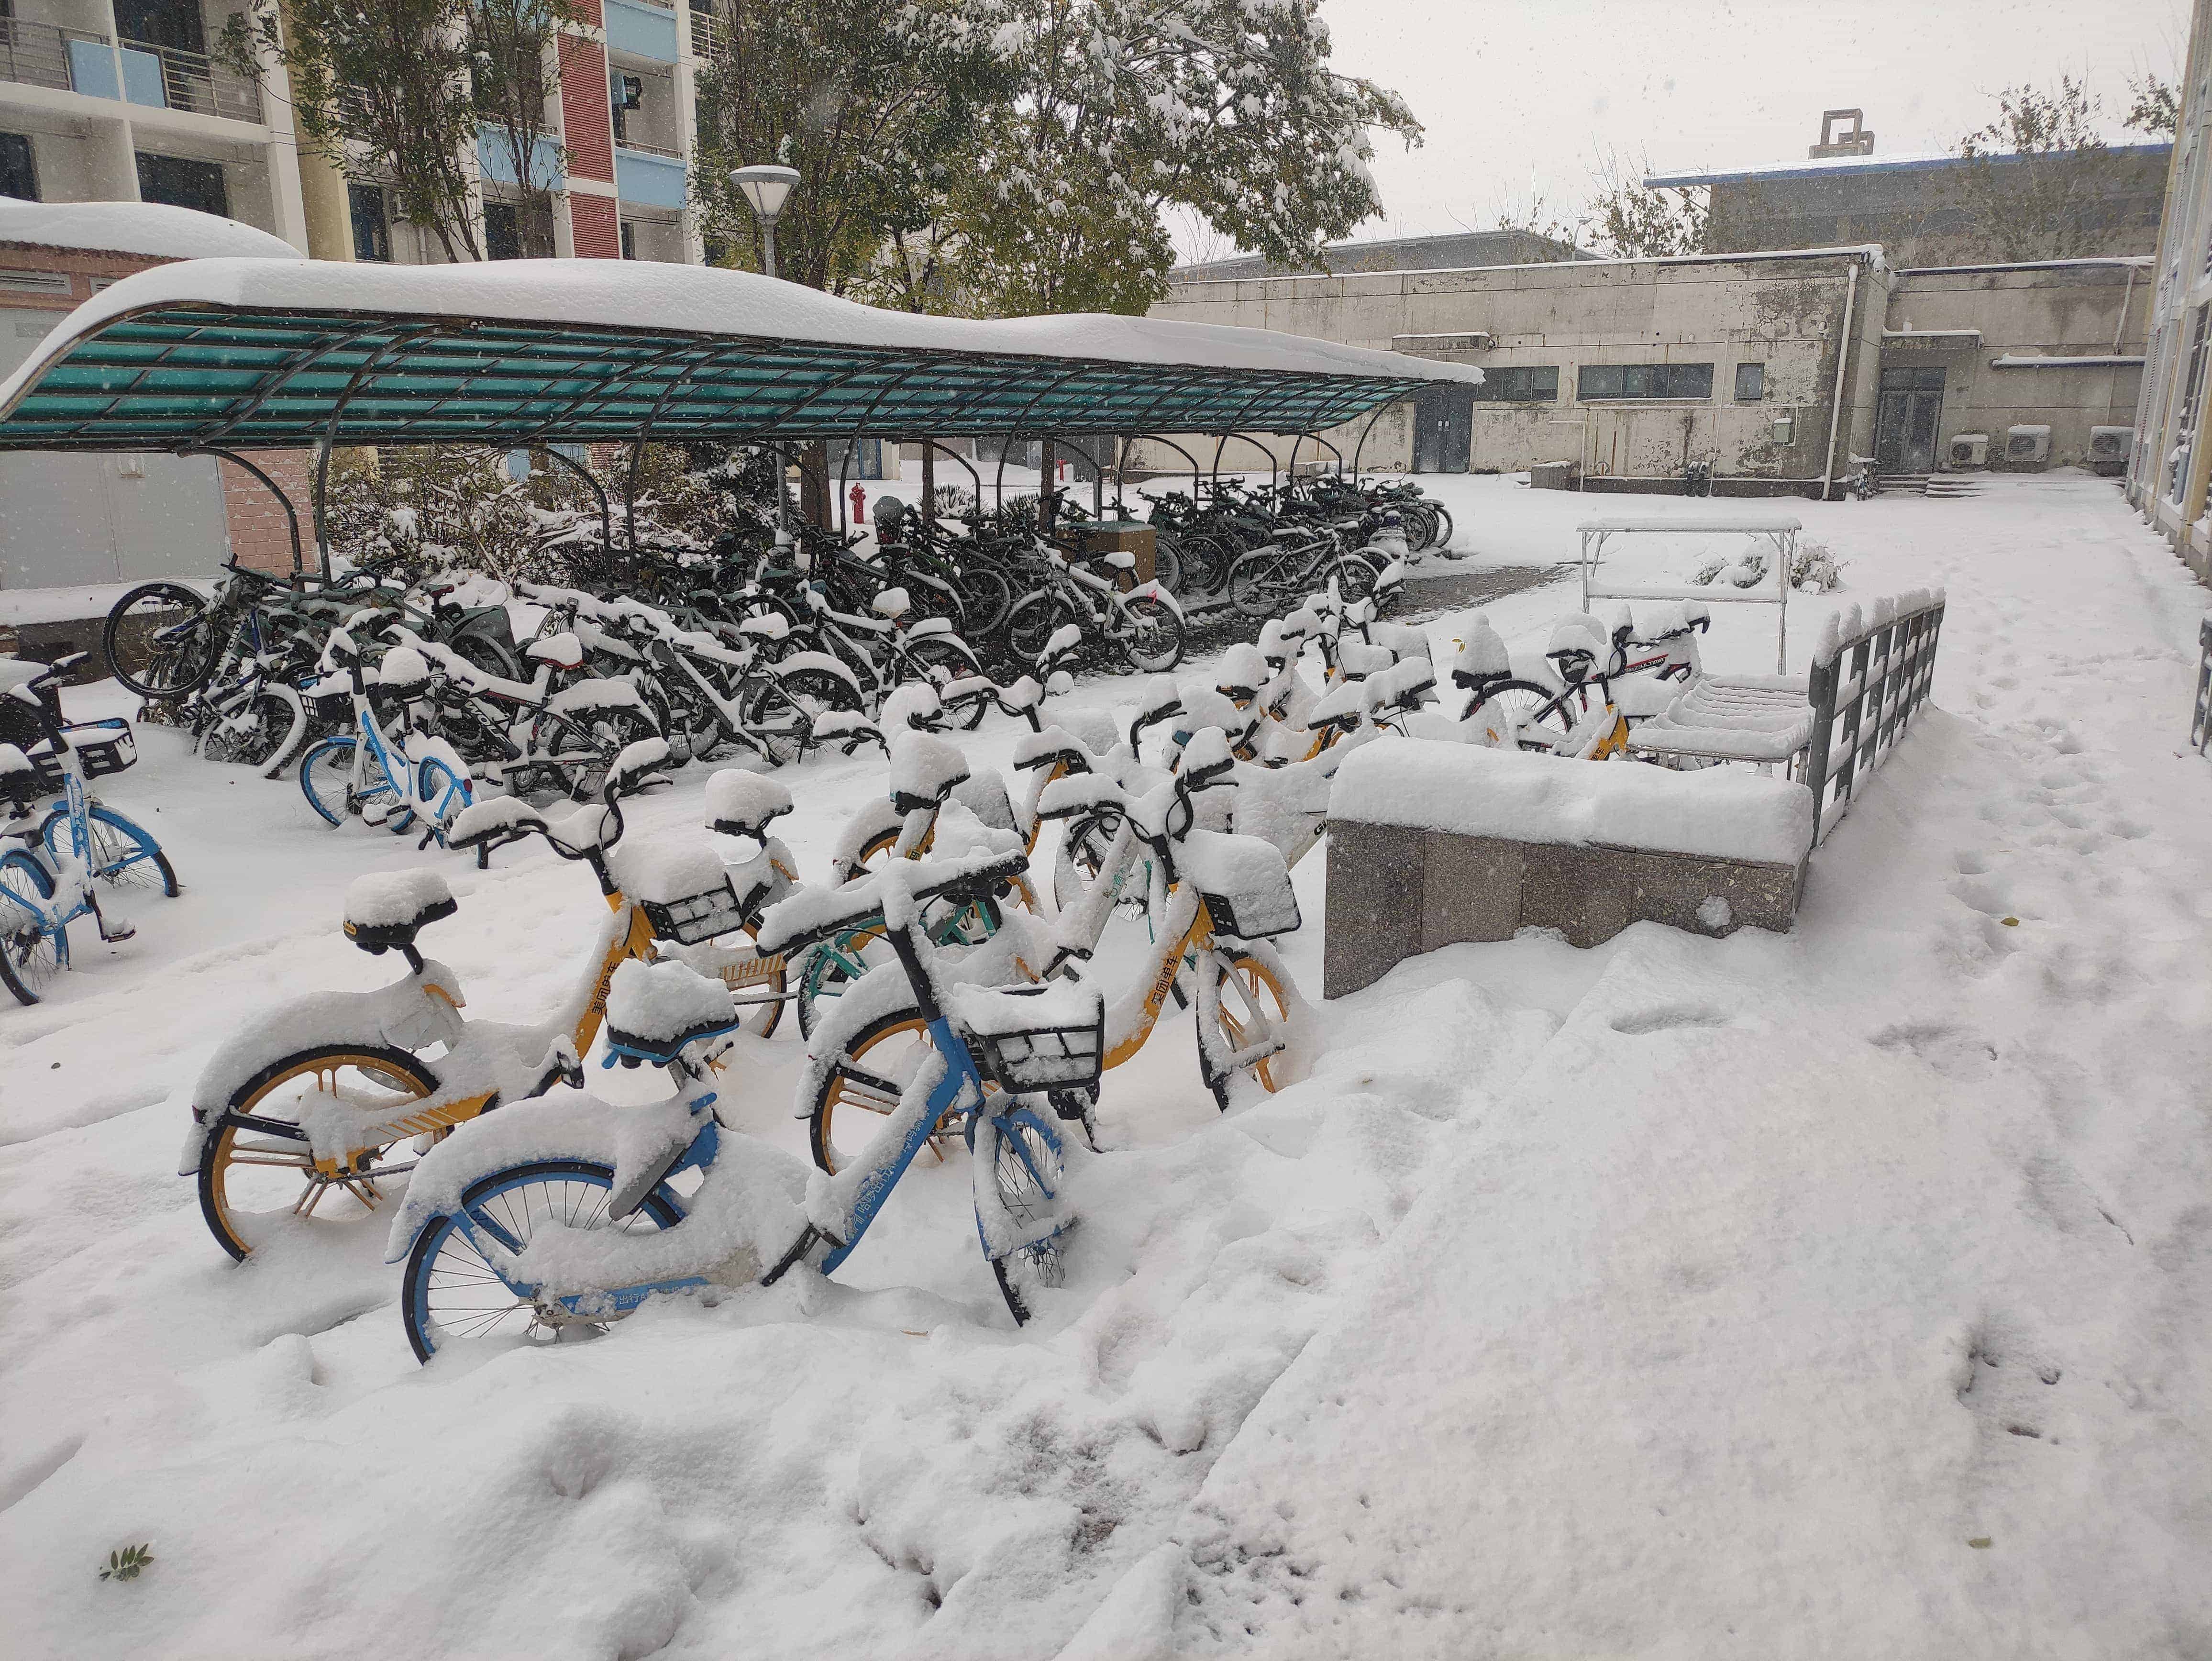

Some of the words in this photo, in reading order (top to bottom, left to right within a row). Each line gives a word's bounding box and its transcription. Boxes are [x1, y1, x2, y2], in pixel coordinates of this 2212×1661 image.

[465, 701, 513, 744] WOLF
[1150, 955, 1178, 1005] 美团单车
